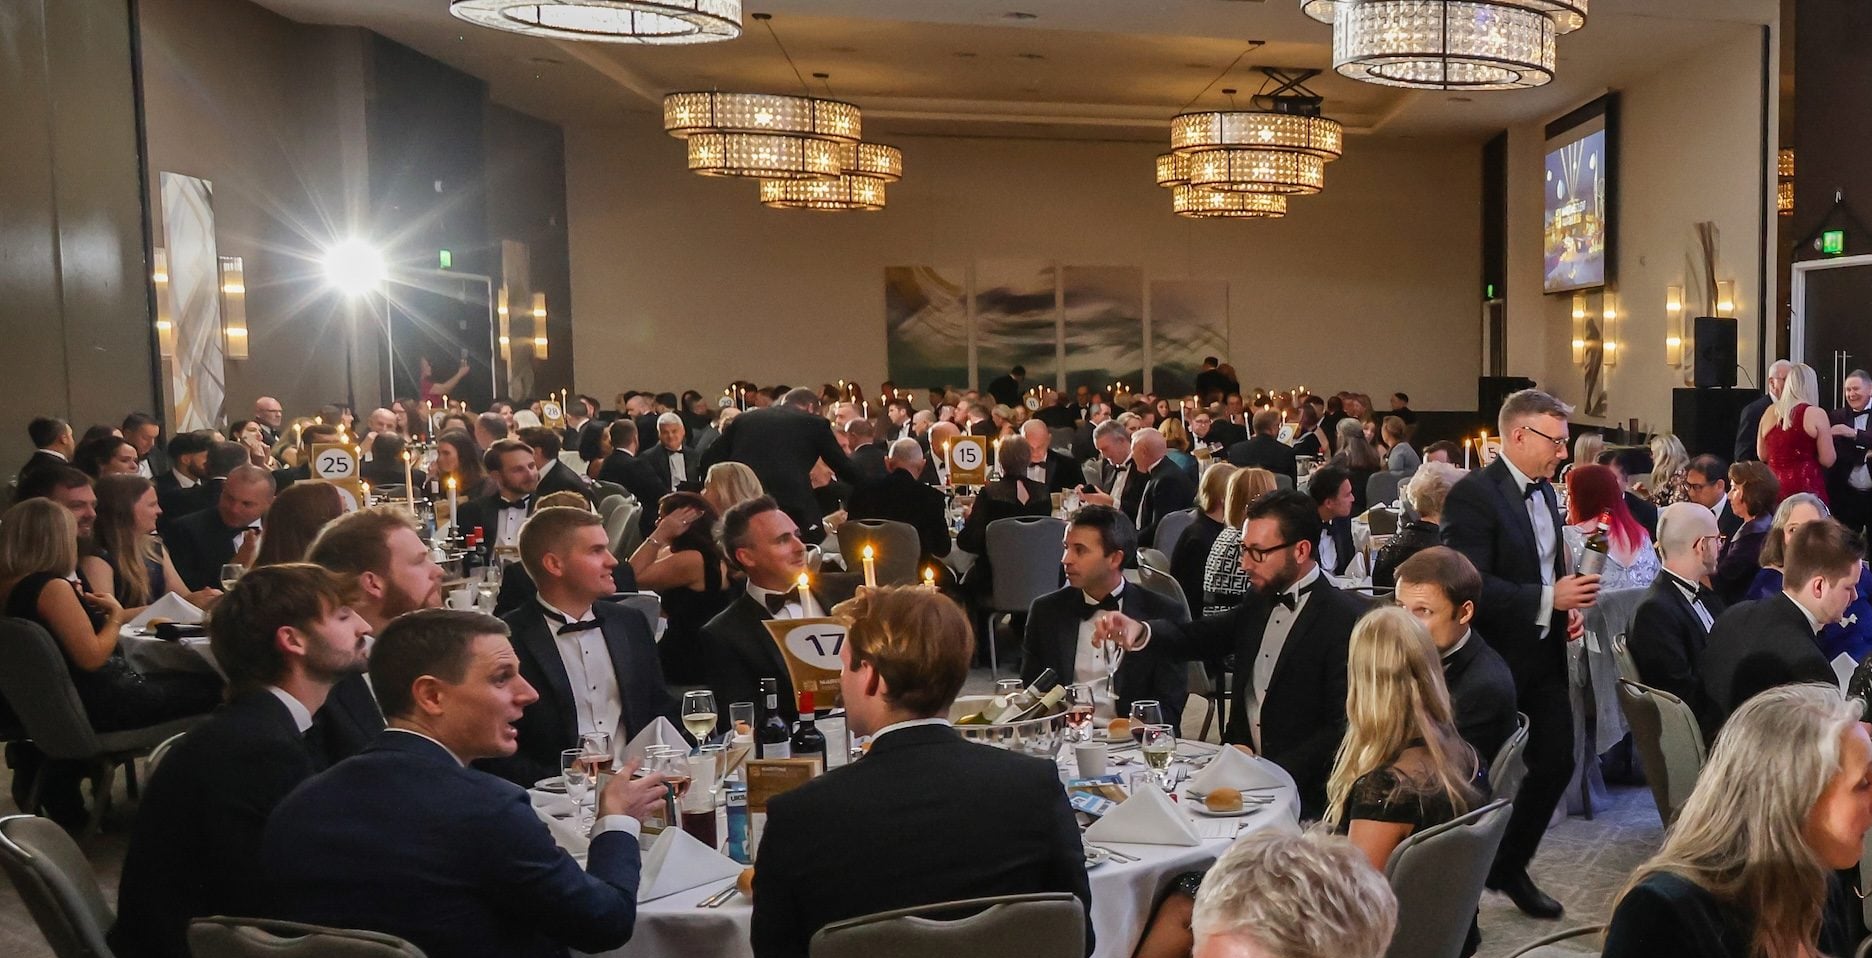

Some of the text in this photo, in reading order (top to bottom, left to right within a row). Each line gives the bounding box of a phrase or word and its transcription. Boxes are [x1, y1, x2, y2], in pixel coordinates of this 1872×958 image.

[547, 408, 557, 416] 28
[1279, 431, 1286, 440] 6
[959, 448, 976, 463] 15
[323, 457, 348, 472] 25
[805, 633, 844, 656] 17
